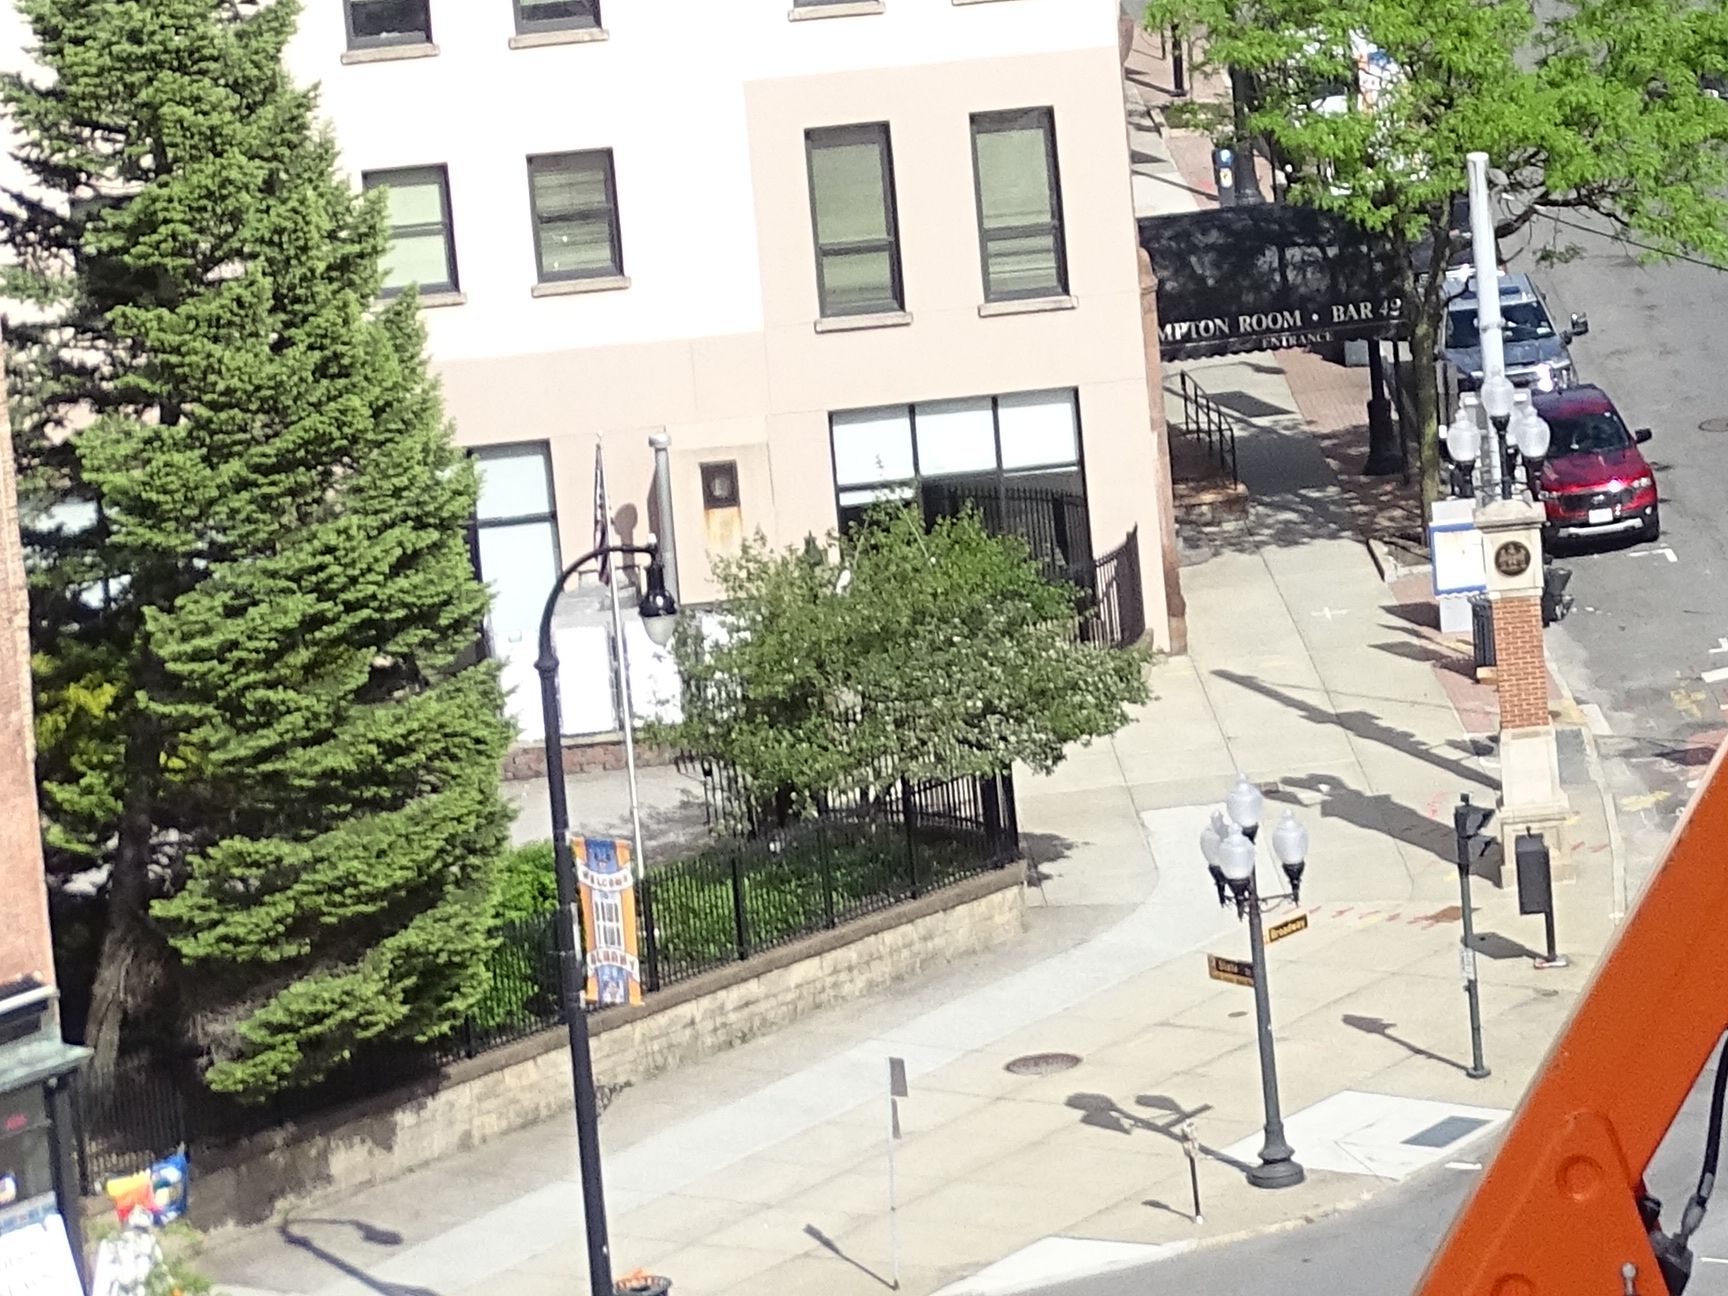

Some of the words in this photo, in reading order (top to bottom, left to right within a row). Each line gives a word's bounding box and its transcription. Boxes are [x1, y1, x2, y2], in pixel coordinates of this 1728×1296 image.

[1238, 310, 1303, 335] ROOM
[1332, 301, 1374, 323] BAR
[1262, 331, 1335, 348] ENTRANCE
[1270, 919, 1306, 940] Broadway
